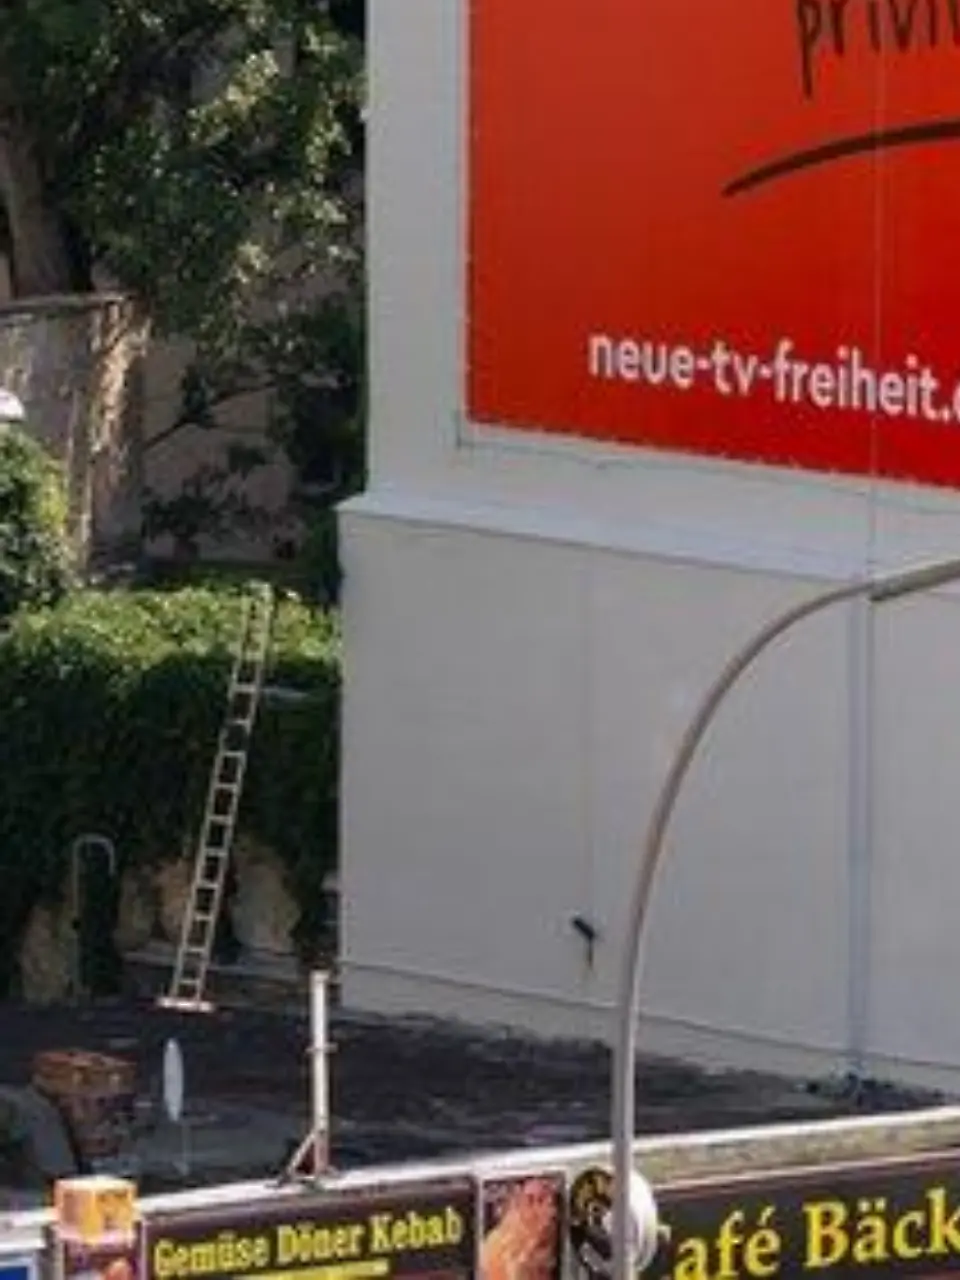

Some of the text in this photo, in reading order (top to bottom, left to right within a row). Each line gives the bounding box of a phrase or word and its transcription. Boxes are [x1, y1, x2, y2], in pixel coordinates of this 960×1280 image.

[153, 1206, 462, 1278] Gemüse Döner Kebab
[657, 1206, 782, 1280] afé
